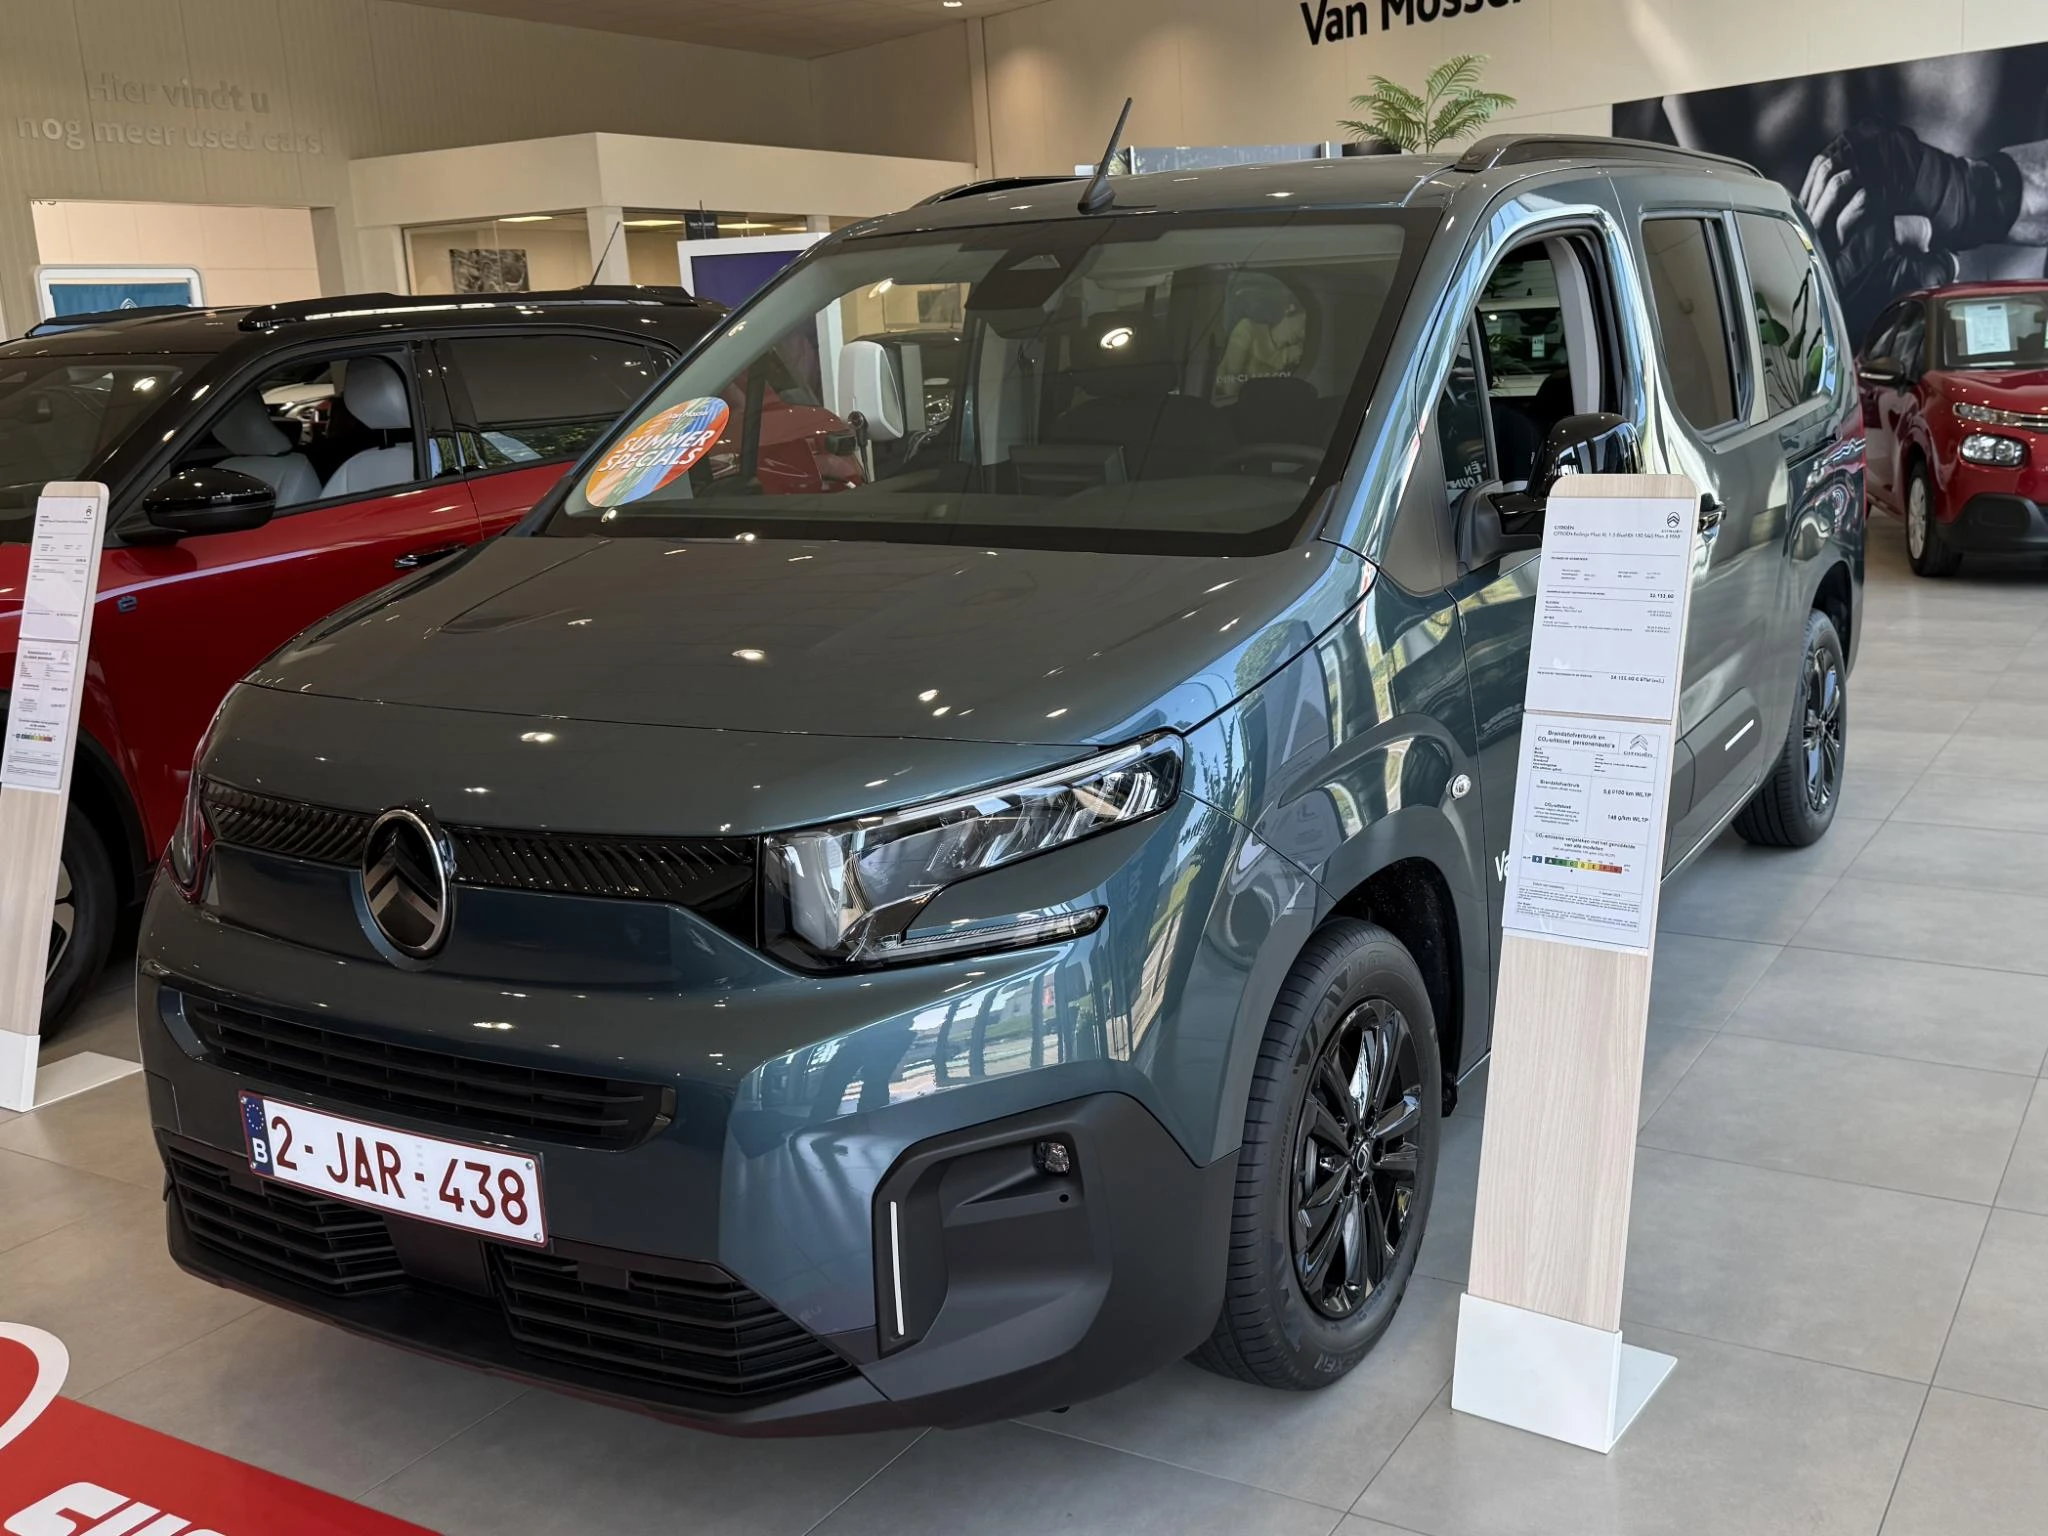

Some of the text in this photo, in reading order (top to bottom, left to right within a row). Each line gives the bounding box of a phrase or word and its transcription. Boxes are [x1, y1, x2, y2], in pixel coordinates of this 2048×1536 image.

[1300, 0, 1368, 45] Van
[89, 74, 270, 113] Hier vindt u
[16, 116, 86, 150] nog
[94, 118, 176, 147] meer
[187, 122, 256, 151] used
[598, 448, 704, 472] SPECIALS
[616, 430, 716, 453] SUMMER
[252, 1115, 528, 1226] B 2-JAR-438
